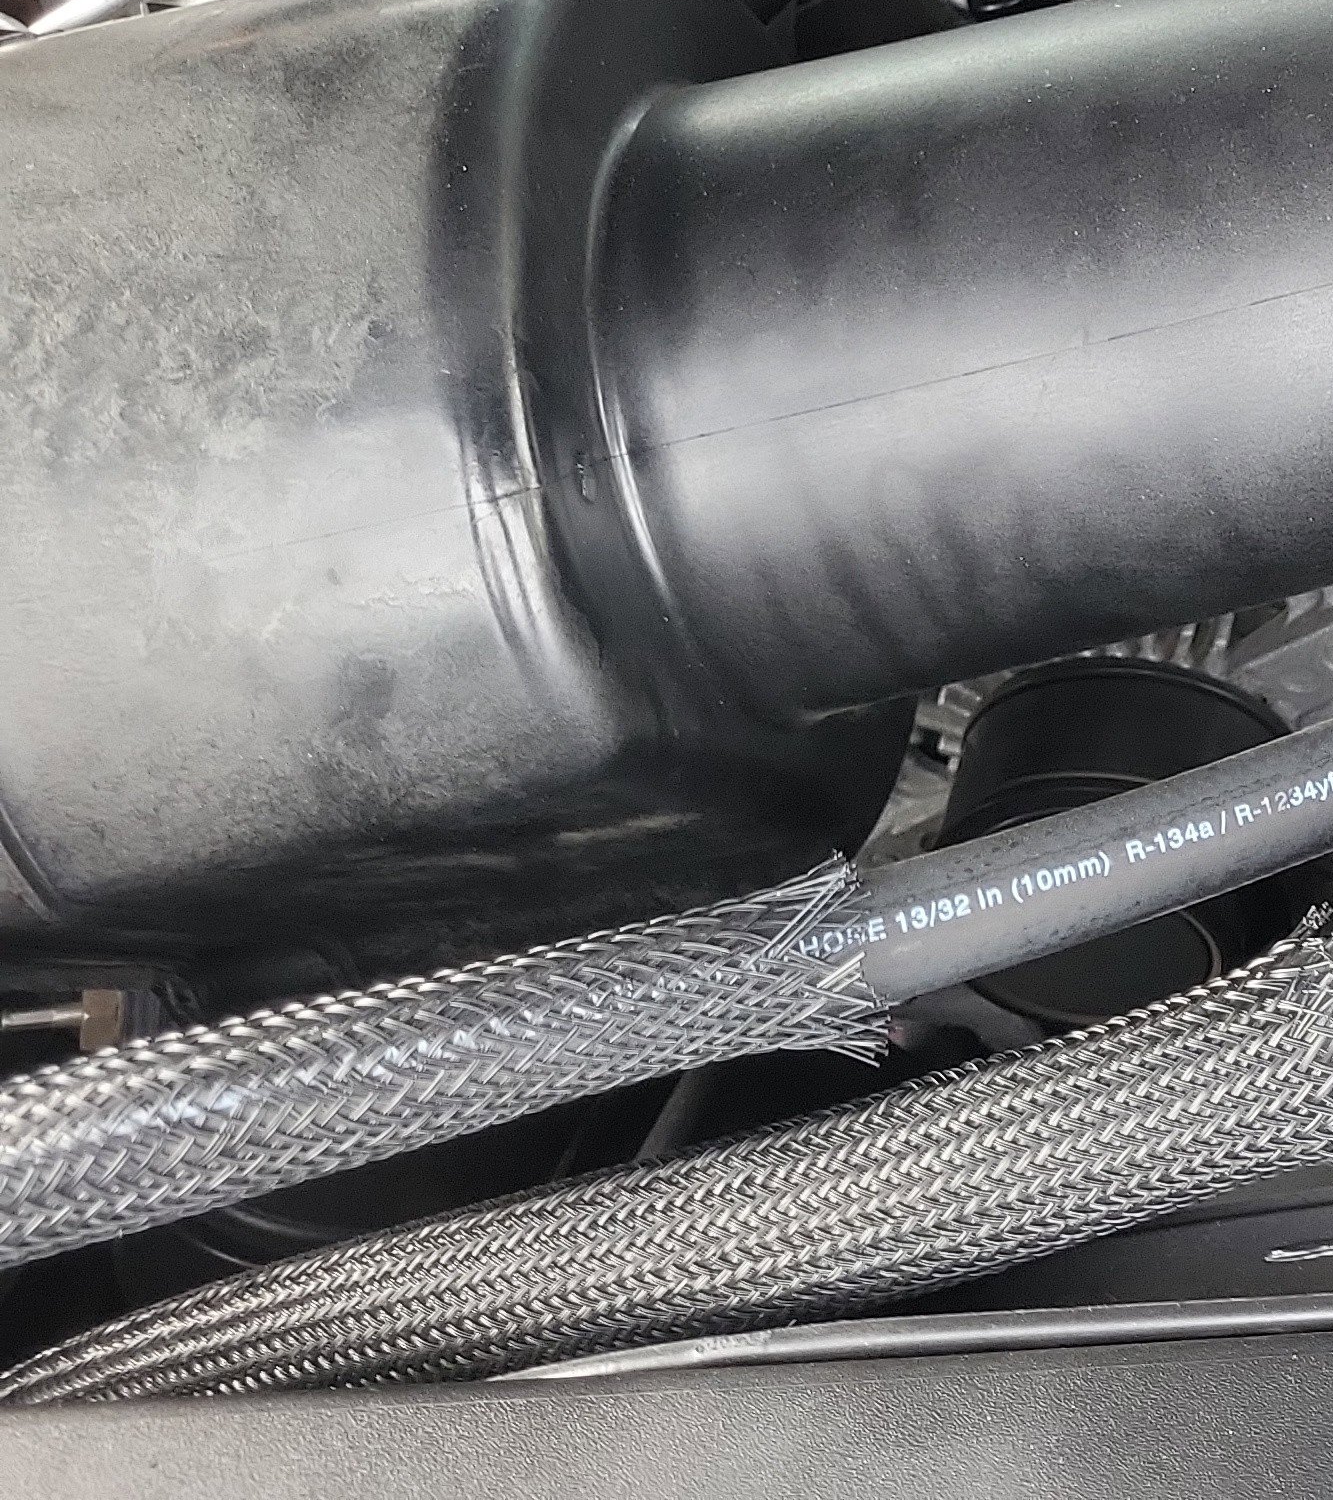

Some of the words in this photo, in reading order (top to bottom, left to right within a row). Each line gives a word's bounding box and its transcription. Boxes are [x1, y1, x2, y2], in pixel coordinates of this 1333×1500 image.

[895, 893, 972, 934] 13/32
[1011, 851, 1111, 904] (10mm)
[1125, 820, 1215, 863] R-134a
